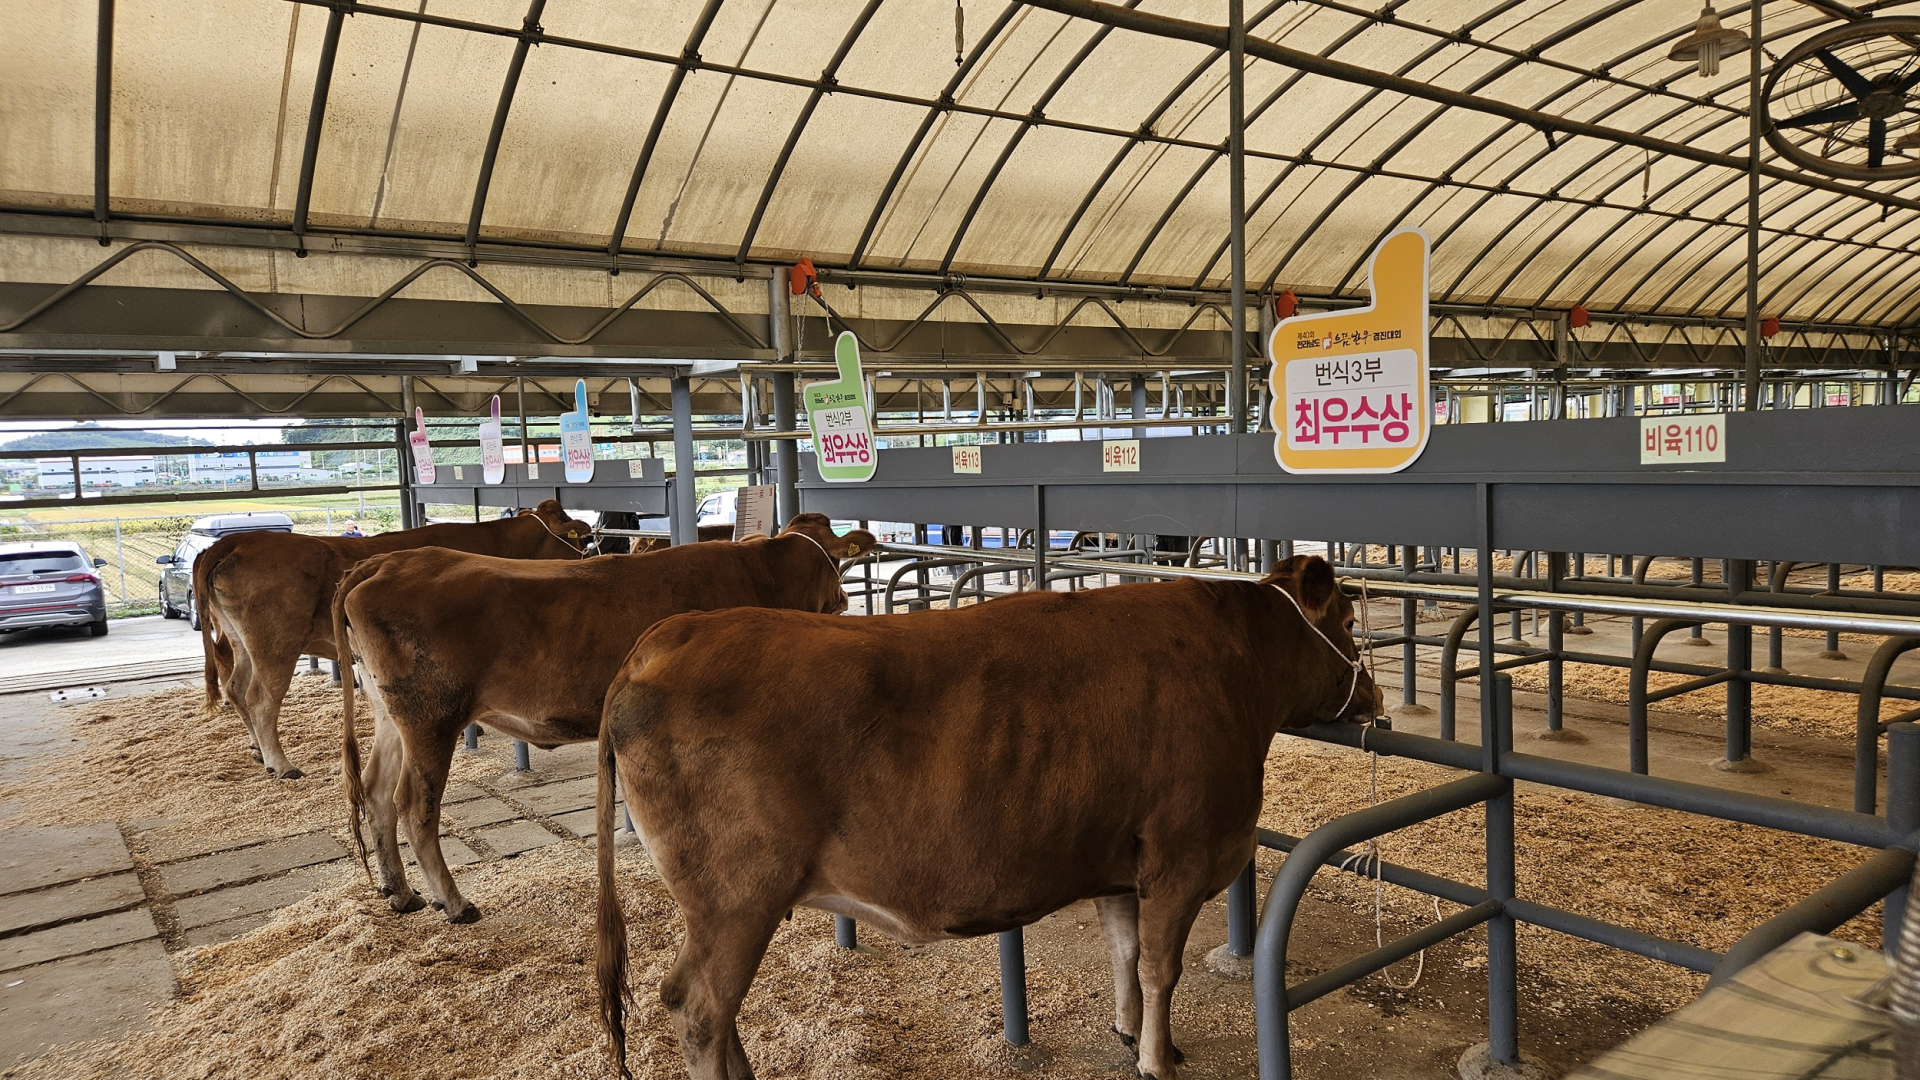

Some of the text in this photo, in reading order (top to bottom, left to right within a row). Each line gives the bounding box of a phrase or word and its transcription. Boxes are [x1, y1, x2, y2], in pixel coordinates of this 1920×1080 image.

[1297, 331, 1315, 339] 제40회
[1297, 338, 1320, 349] 전라남도
[1373, 329, 1402, 341] 경진대회
[1315, 357, 1383, 386] 번식3부
[825, 410, 853, 428] 번식2부
[1295, 393, 1413, 445] 최우수상
[822, 432, 870, 464] 최우수상
[1646, 424, 1718, 456] 비육110
[954, 450, 980, 470] 비육113
[1105, 445, 1137, 467] 비육112
